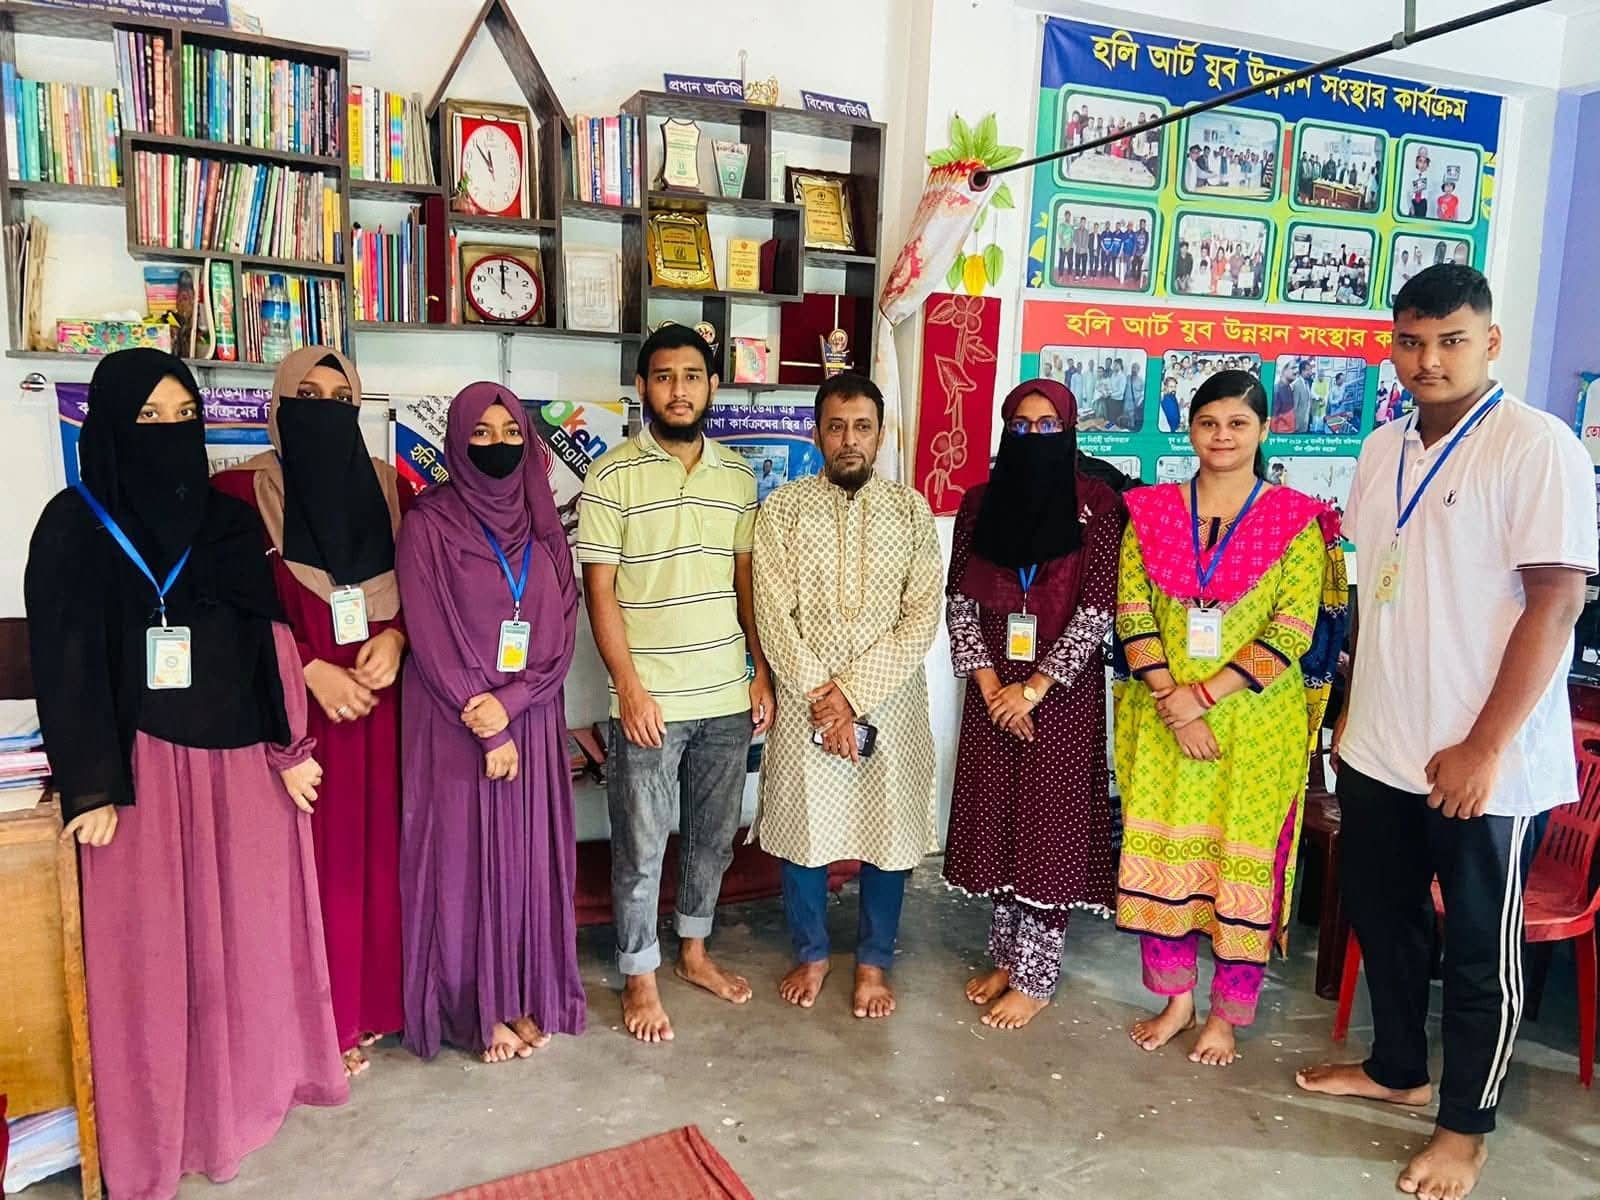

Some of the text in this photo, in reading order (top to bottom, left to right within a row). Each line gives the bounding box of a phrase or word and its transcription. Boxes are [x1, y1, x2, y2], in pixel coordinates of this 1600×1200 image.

[1090, 29, 1140, 71] হলি
[1146, 40, 1200, 77] আর্ট
[1203, 53, 1240, 90] যুব
[1320, 74, 1388, 112] সংস্থার
[1392, 85, 1468, 122] কার্যক্রম
[669, 79, 743, 96] প্রধান অতিথি
[805, 94, 836, 113] বিশেষ
[477, 275, 486, 283] 10
[487, 267, 494, 275] 11
[515, 271, 519, 279] 1
[522, 280, 529, 288] 2
[1063, 308, 1115, 338] হলি
[1121, 312, 1174, 338] আর্ট
[1180, 319, 1215, 344] যুব
[1224, 316, 1292, 346] উন্নয়ন
[1299, 326, 1367, 351] সংস্থার
[410, 443, 437, 469] হলি
[550, 430, 589, 474] Englis
